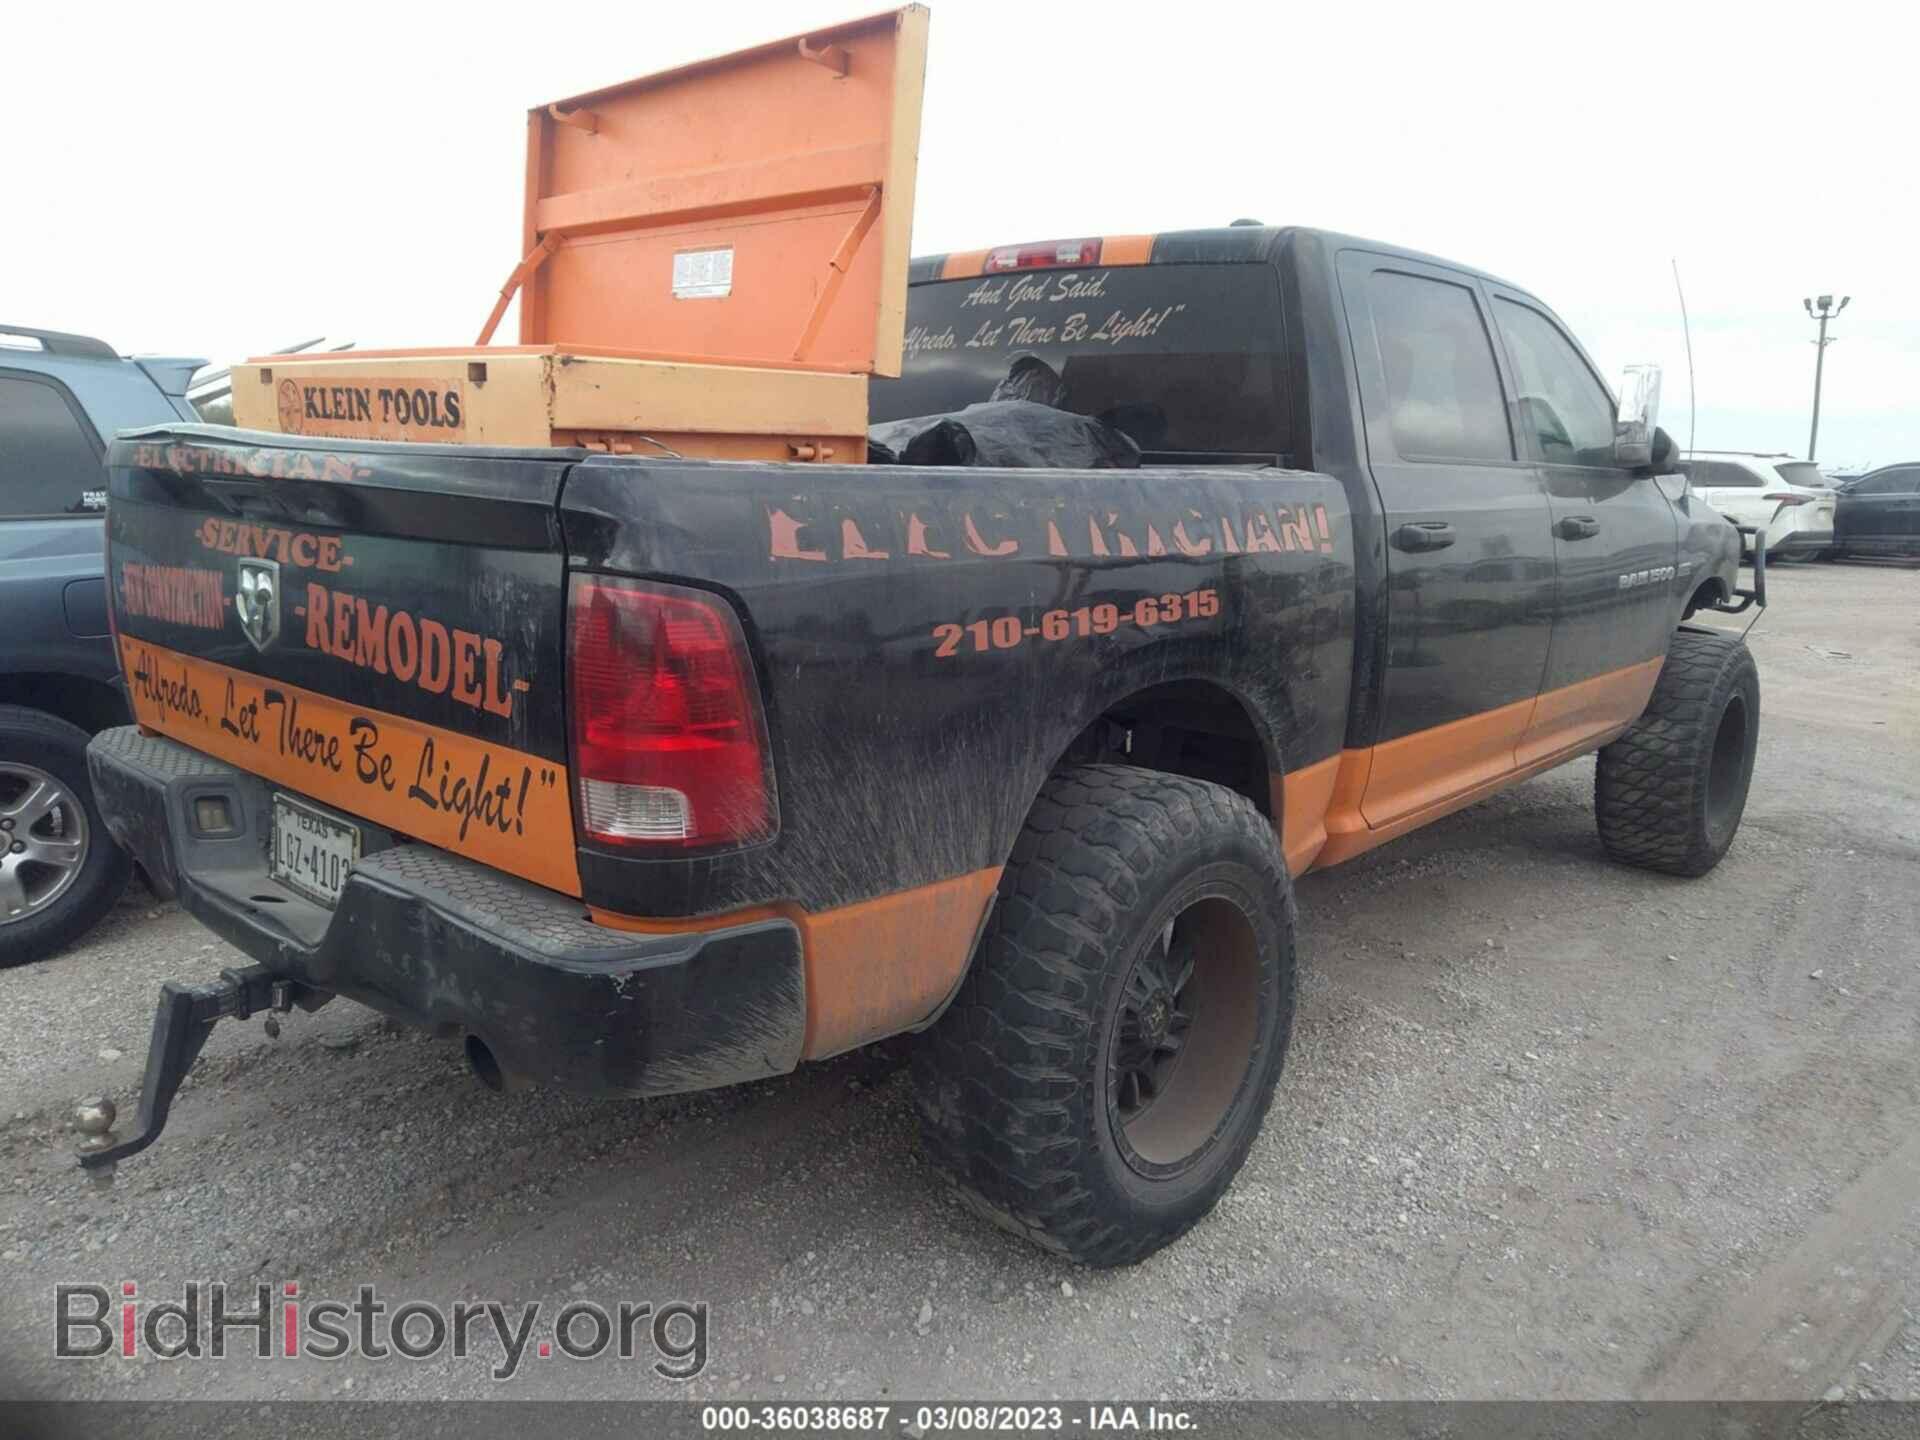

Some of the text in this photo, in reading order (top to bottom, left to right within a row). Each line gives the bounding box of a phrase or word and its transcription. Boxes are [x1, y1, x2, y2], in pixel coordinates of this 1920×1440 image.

[960, 280, 1003, 308] And
[1005, 275, 1049, 311] God
[965, 320, 1002, 348] Let
[1008, 317, 1056, 347] There
[1060, 312, 1088, 341] Be
[303, 386, 462, 428] KLEIN TOOLS
[932, 588, 1220, 659] 210-619-6315
[220, 677, 260, 743] Let
[264, 688, 342, 772] There
[349, 717, 396, 791] Be
[296, 813, 329, 840] TEXAS
